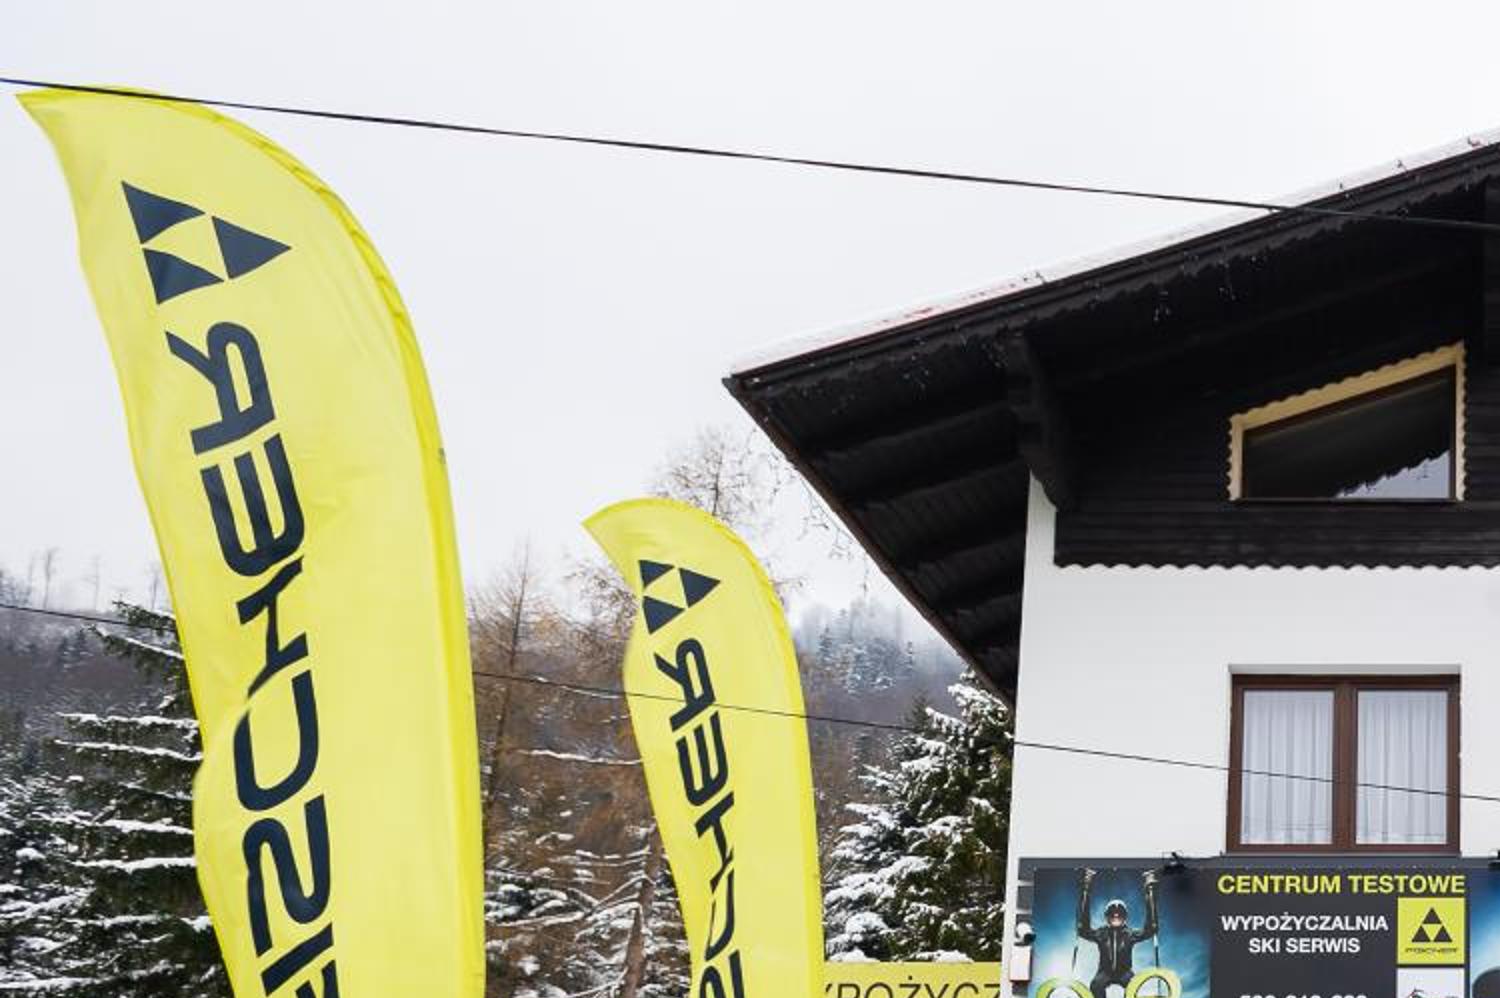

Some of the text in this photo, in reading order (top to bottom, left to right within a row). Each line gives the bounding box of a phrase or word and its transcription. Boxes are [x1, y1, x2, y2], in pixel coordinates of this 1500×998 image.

[1217, 874, 1466, 894] CENTRUM TESTOWE
[1221, 911, 1389, 932] WYPOŻYCZALNIA
[1248, 938, 1361, 954] SKI SERWIS
